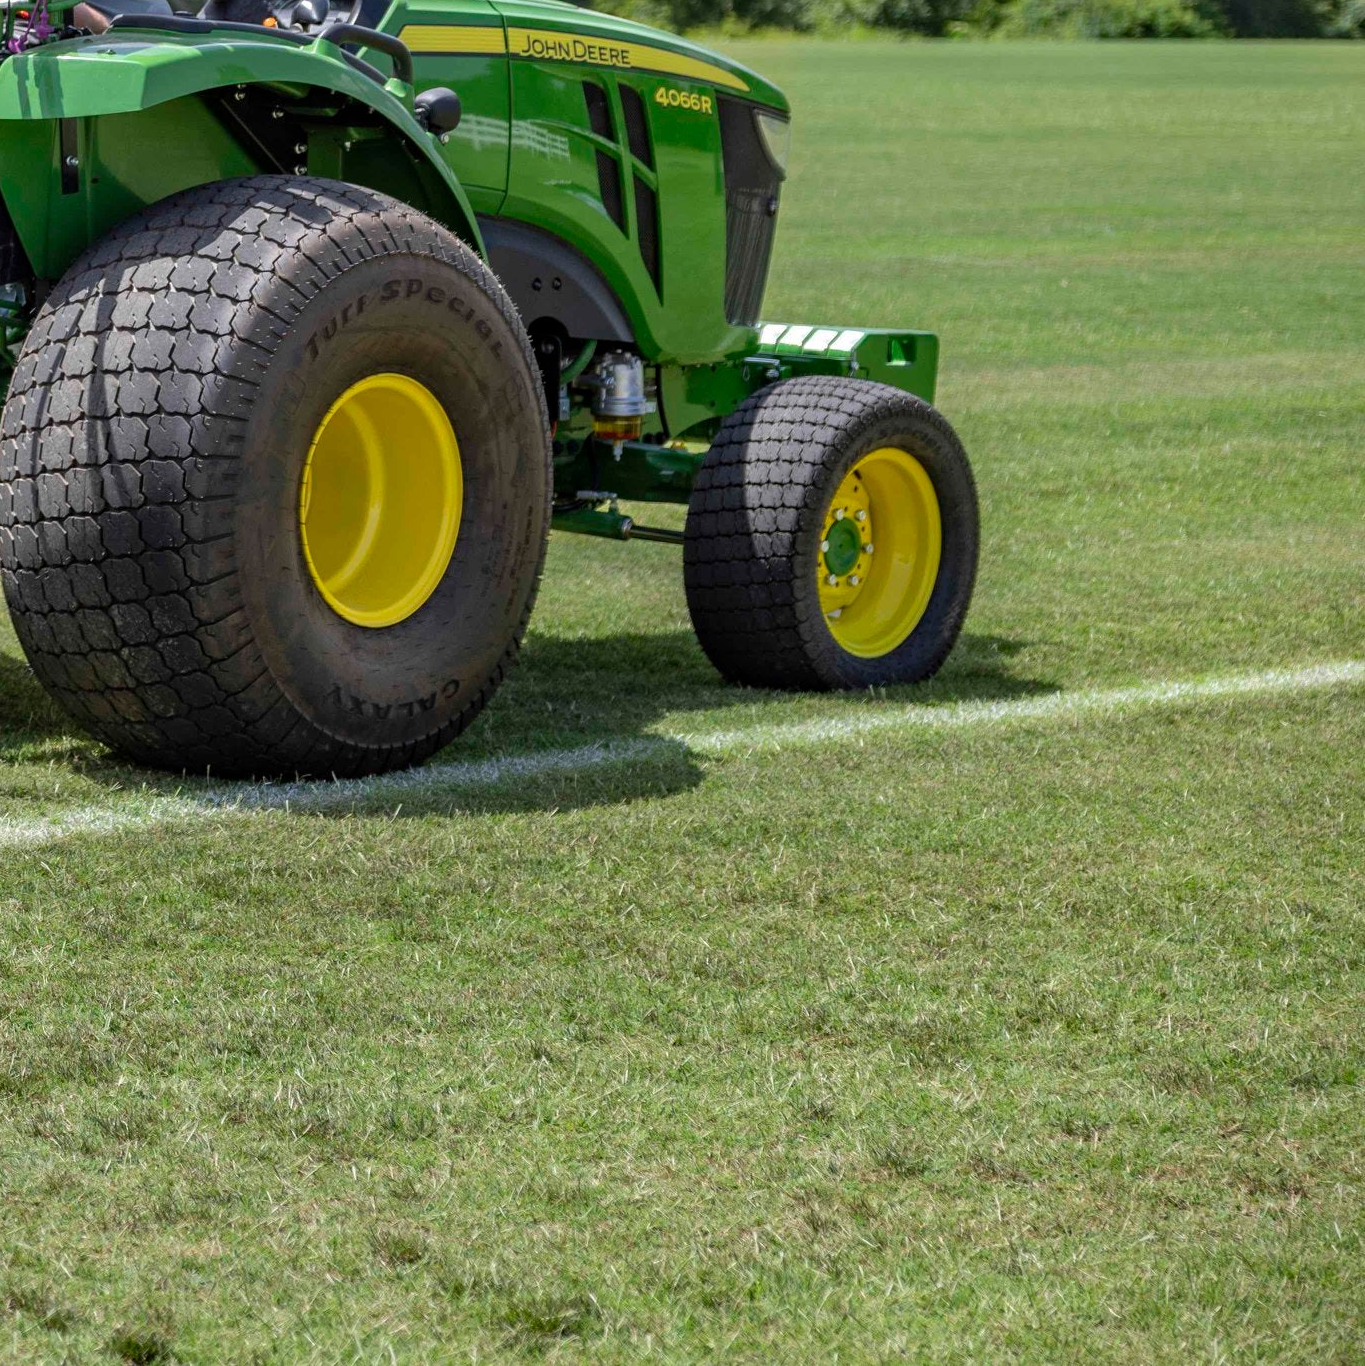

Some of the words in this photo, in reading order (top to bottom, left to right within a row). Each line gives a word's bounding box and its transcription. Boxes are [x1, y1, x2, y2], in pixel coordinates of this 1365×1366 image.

[521, 34, 570, 59] JOHN
[572, 39, 632, 66] DEERE
[655, 86, 713, 115] 4066R
